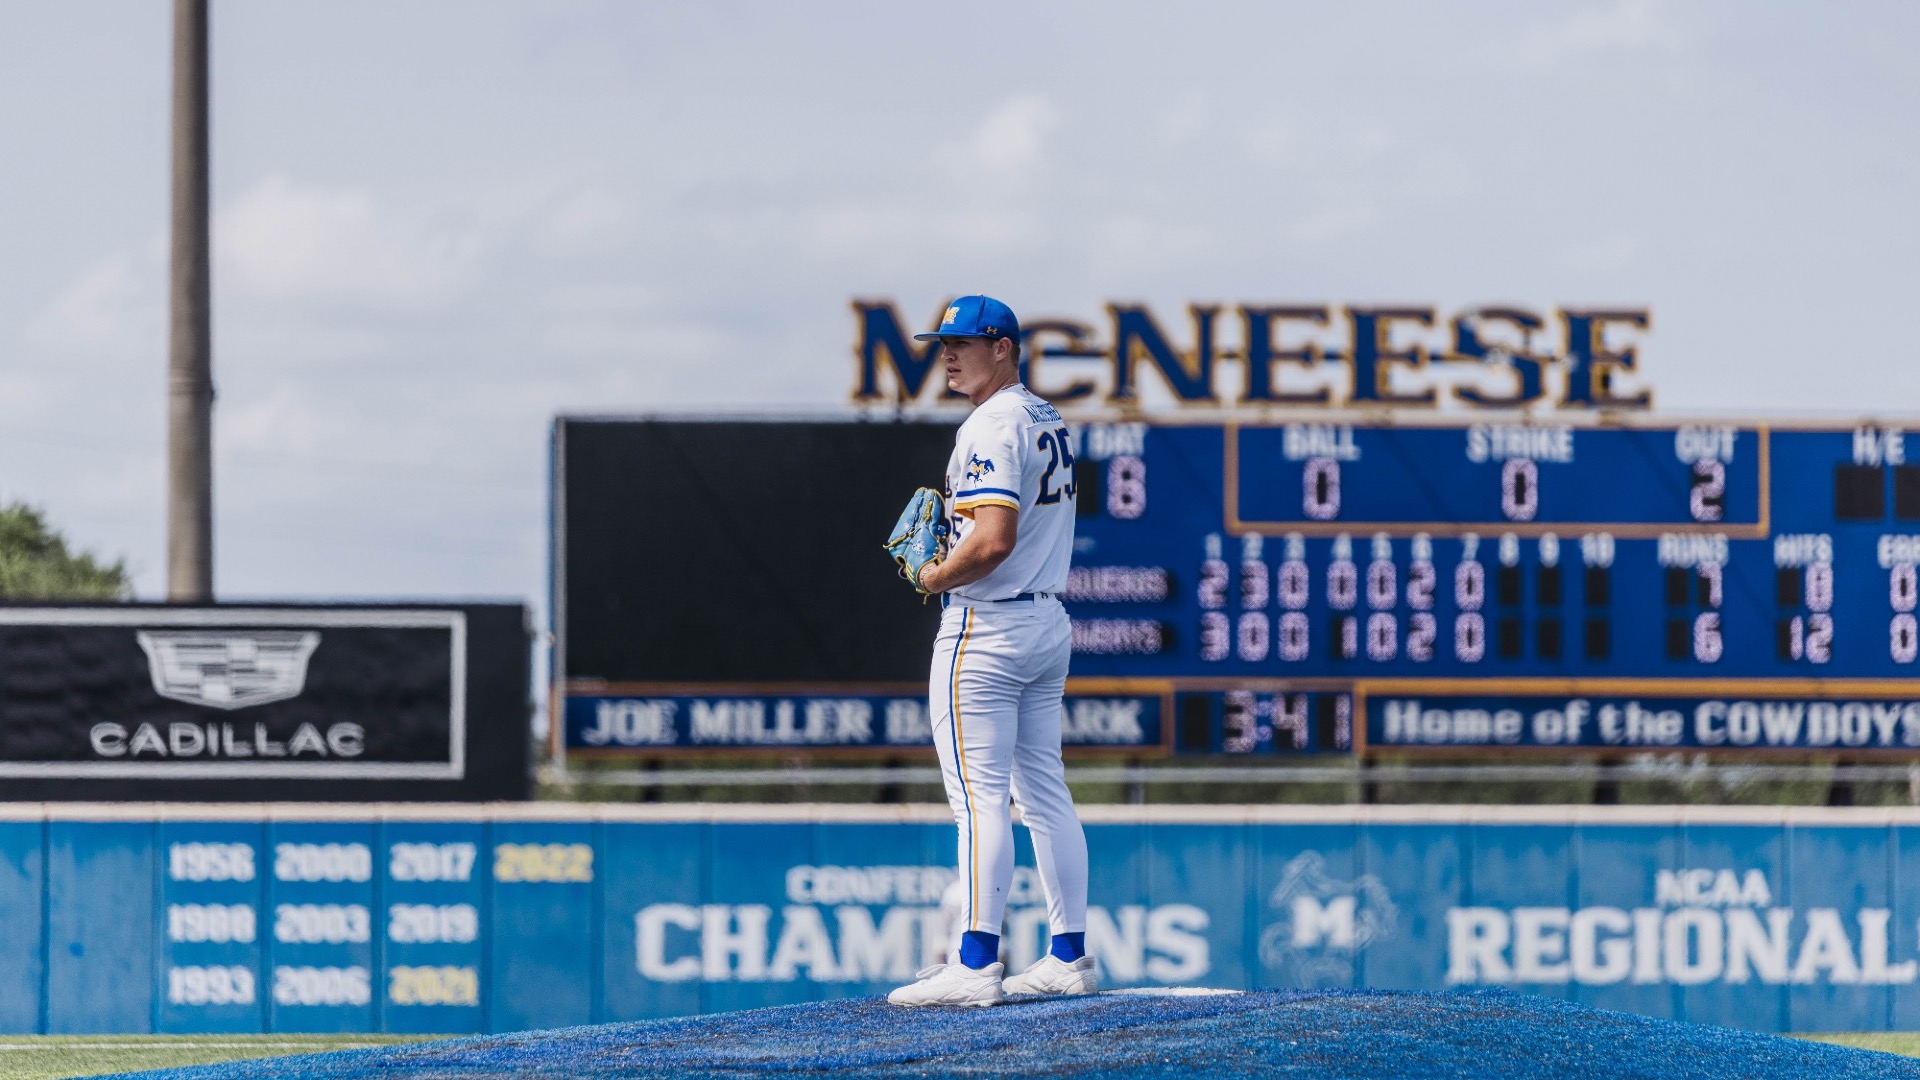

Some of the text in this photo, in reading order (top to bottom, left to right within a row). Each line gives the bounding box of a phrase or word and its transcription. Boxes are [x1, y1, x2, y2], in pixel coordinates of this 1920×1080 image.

[1087, 422, 1150, 461] BAT
[1282, 423, 1361, 461] BALL
[1467, 424, 1575, 463] STRIKE
[1675, 424, 1738, 464] OUT
[1852, 428, 1906, 468] H/E
[1035, 427, 1077, 506] 25
[1303, 456, 1341, 520] 0
[1501, 457, 1539, 521] 0
[1690, 458, 1726, 522] 2
[1459, 532, 1480, 562] 7
[1581, 532, 1615, 567] 10
[1657, 533, 1729, 567] RUNS
[1197, 560, 1229, 610] 2
[1240, 560, 1269, 610] 3
[1277, 560, 1309, 610] 0
[1327, 560, 1357, 610] 0
[1366, 560, 1397, 610] 0
[1406, 560, 1436, 610] 2
[1455, 560, 1485, 611] 0
[1697, 562, 1722, 609] 7
[1890, 562, 1917, 612] 0
[1200, 612, 1230, 662] 3
[1237, 612, 1269, 662] 0
[1278, 612, 1309, 662] 0
[1341, 615, 1357, 659] 1
[1366, 612, 1397, 662] 0
[1406, 612, 1437, 663] 2
[1455, 612, 1485, 663] 0
[1694, 612, 1723, 663] 6
[1790, 613, 1833, 664] 12
[1890, 613, 1917, 664] 0
[90, 722, 366, 757] CADILLAC
[583, 699, 678, 745] JOE
[690, 699, 874, 745] MILLER
[1223, 690, 1351, 752] 3:41
[1384, 700, 1522, 744] Home
[1532, 700, 1590, 744] of
[1598, 701, 1684, 744] the
[274, 842, 372, 882] 2000
[389, 842, 476, 882] 2017
[494, 843, 594, 882] 2022
[785, 864, 1045, 906] CONFERC
[1655, 868, 1772, 907] NCAA
[273, 903, 370, 943] 2003
[389, 903, 479, 943] 2019
[1292, 896, 1356, 948] M
[1446, 907, 1920, 984] REGIONAL
[168, 965, 255, 1005] 1993
[389, 965, 480, 1006] 2021
